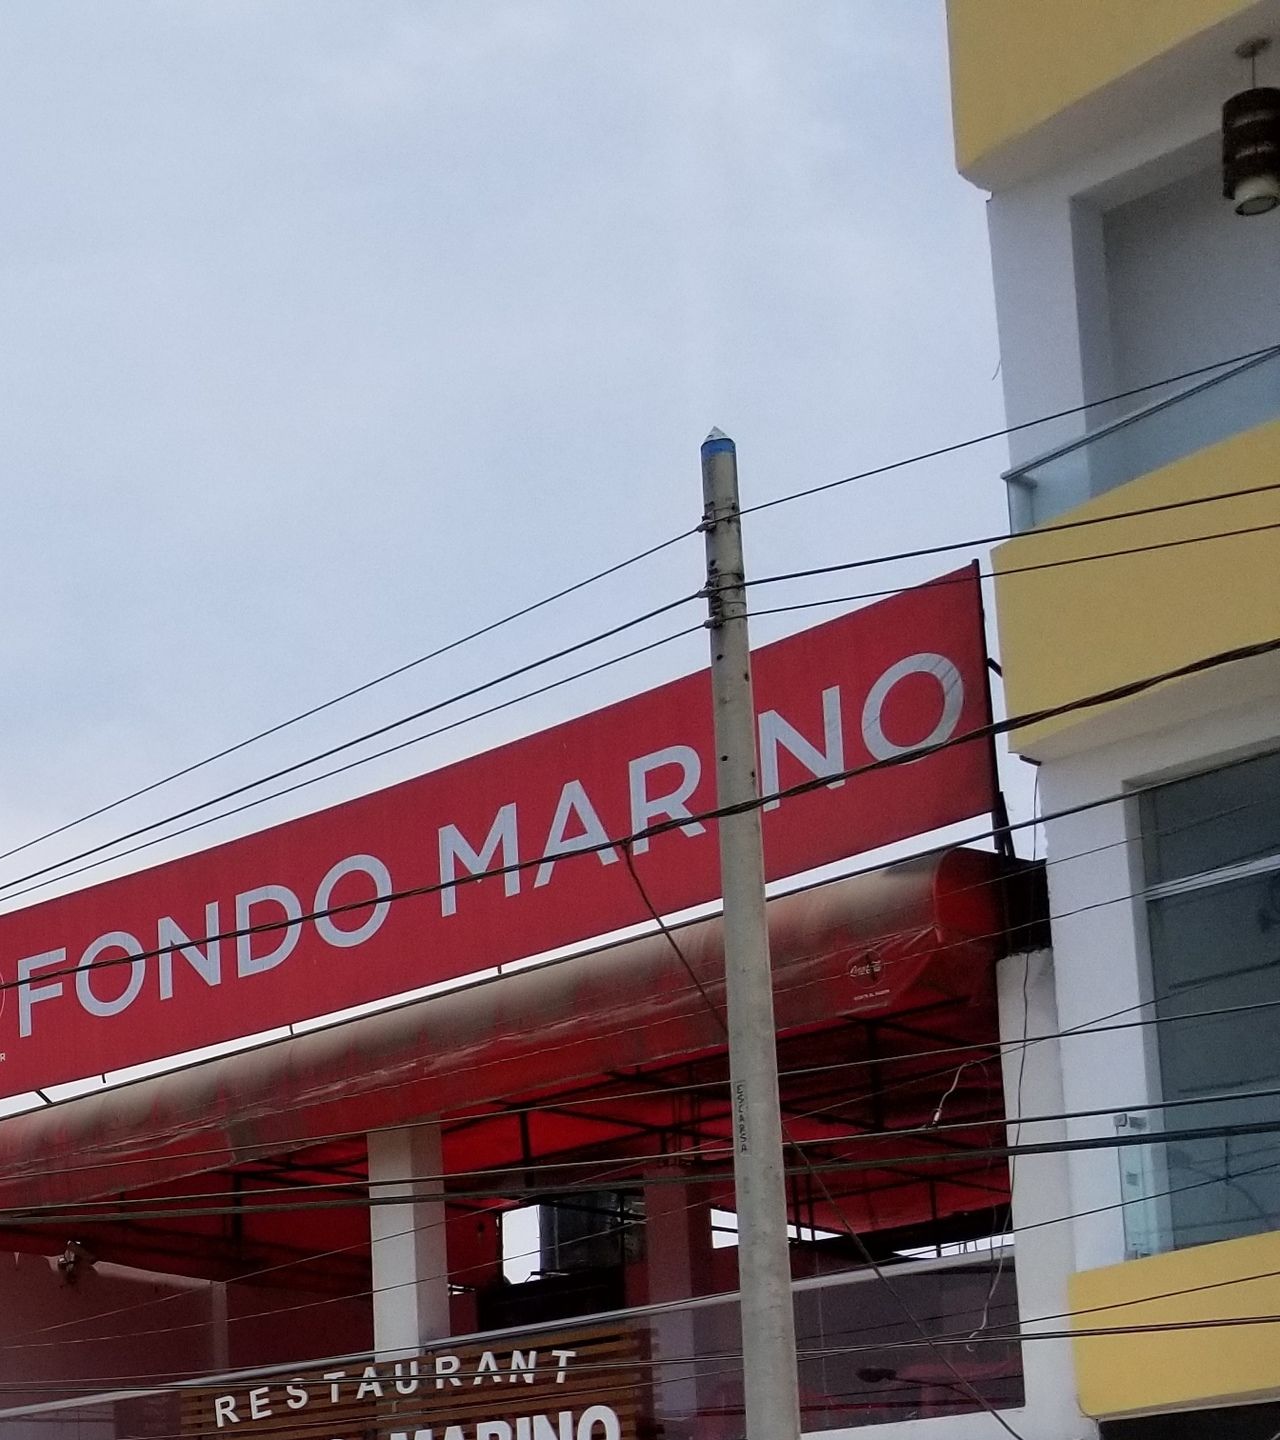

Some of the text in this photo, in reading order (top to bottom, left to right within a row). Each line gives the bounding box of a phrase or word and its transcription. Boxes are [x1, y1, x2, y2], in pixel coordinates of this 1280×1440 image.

[17, 652, 966, 1038] FONDO MARNO
[214, 1349, 577, 1428] RESTAURANT
